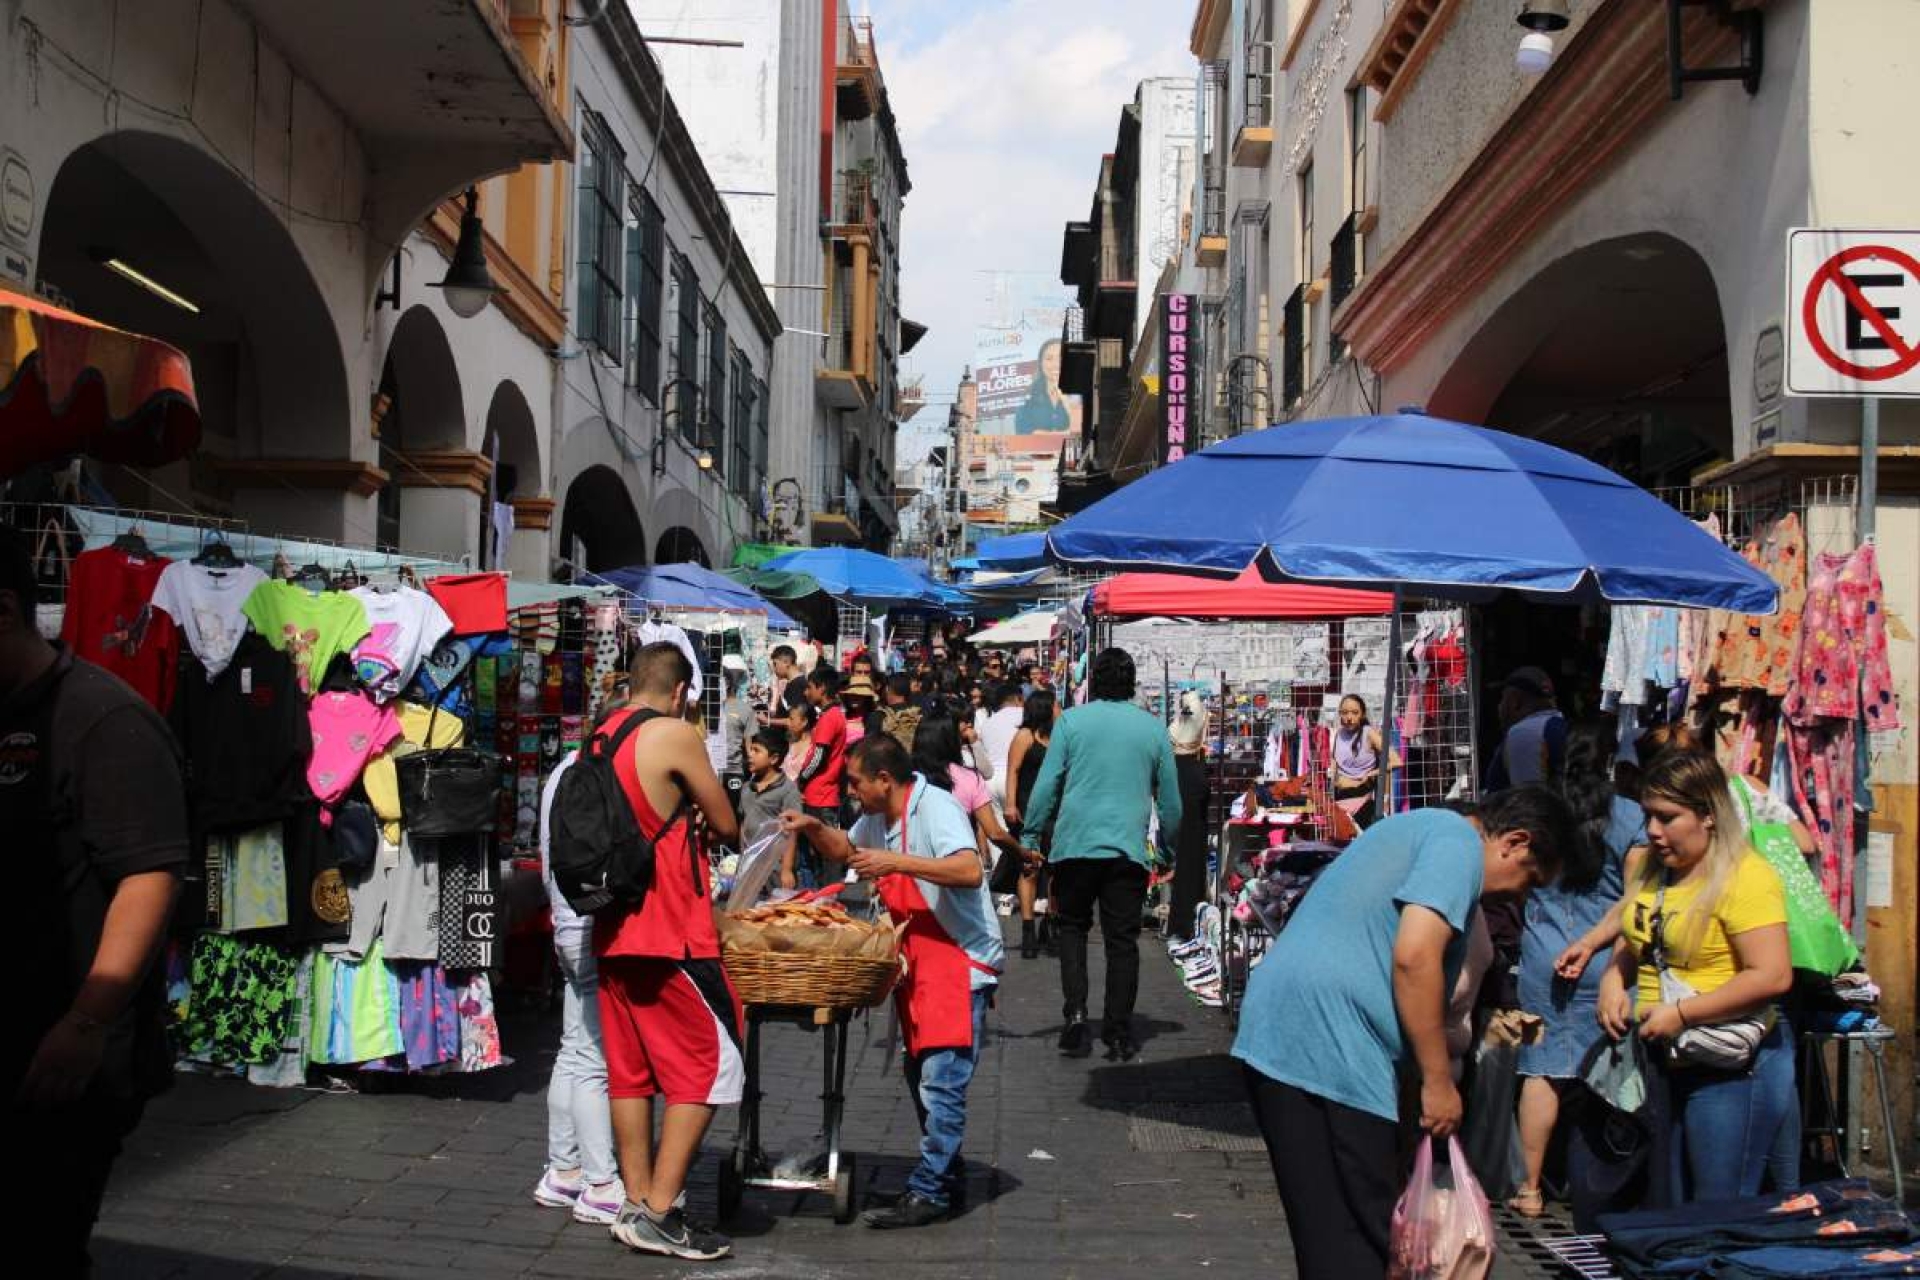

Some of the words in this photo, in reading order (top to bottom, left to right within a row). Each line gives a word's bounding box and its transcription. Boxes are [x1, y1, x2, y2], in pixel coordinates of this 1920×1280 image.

[1846, 274, 1904, 349] E
[1168, 294, 1188, 392] CURSO
[978, 374, 1033, 393] FLORES
[990, 364, 1018, 379] ALE
